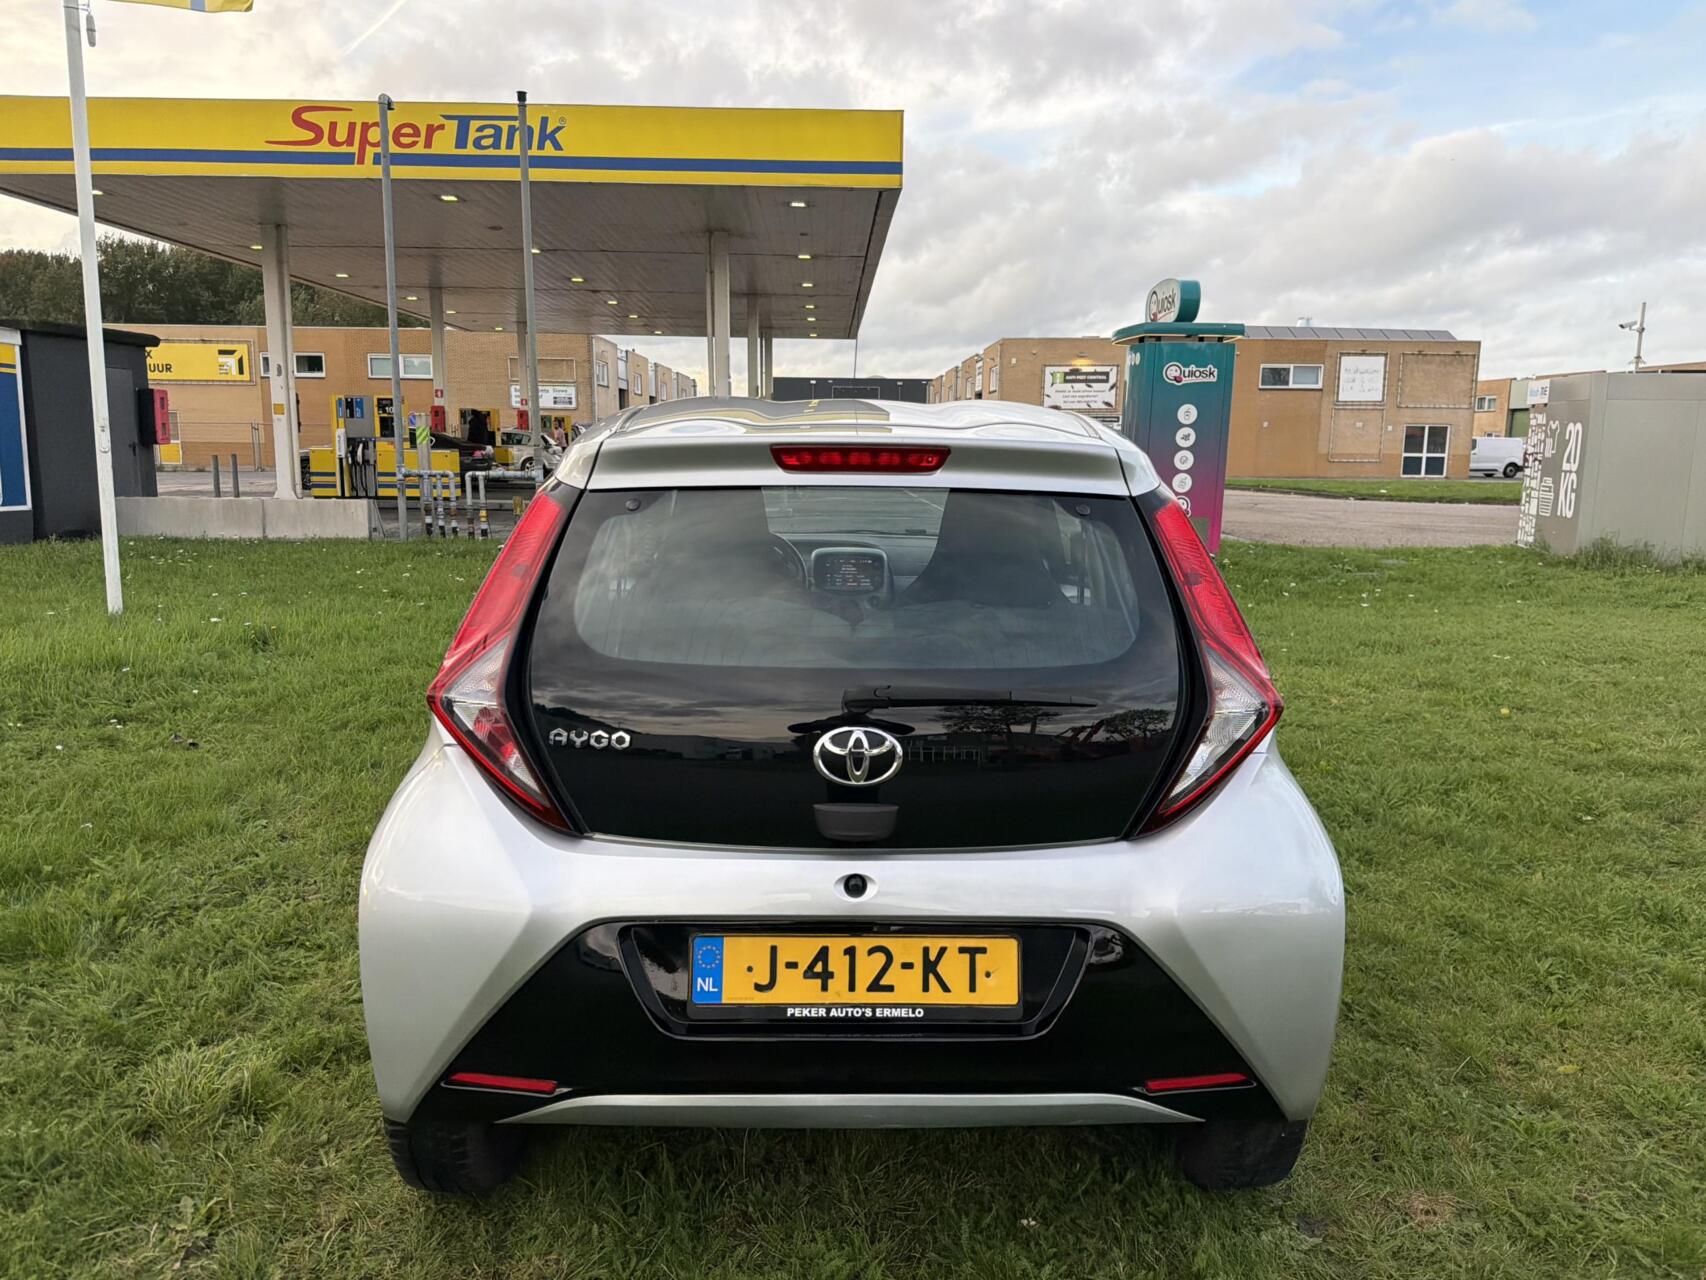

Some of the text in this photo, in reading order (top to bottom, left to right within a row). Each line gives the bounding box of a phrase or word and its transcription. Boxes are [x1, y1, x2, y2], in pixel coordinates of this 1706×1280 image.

[1149, 288, 1177, 322] Quiosk
[1164, 363, 1216, 383] Quiosk
[1562, 422, 1583, 472] 20
[1557, 473, 1577, 519] KG
[548, 727, 631, 750] AYGO
[753, 945, 988, 993] J-412-KT
[696, 977, 718, 992] NL
[786, 1007, 924, 1018] PEKER AUTO'S ERMELO
